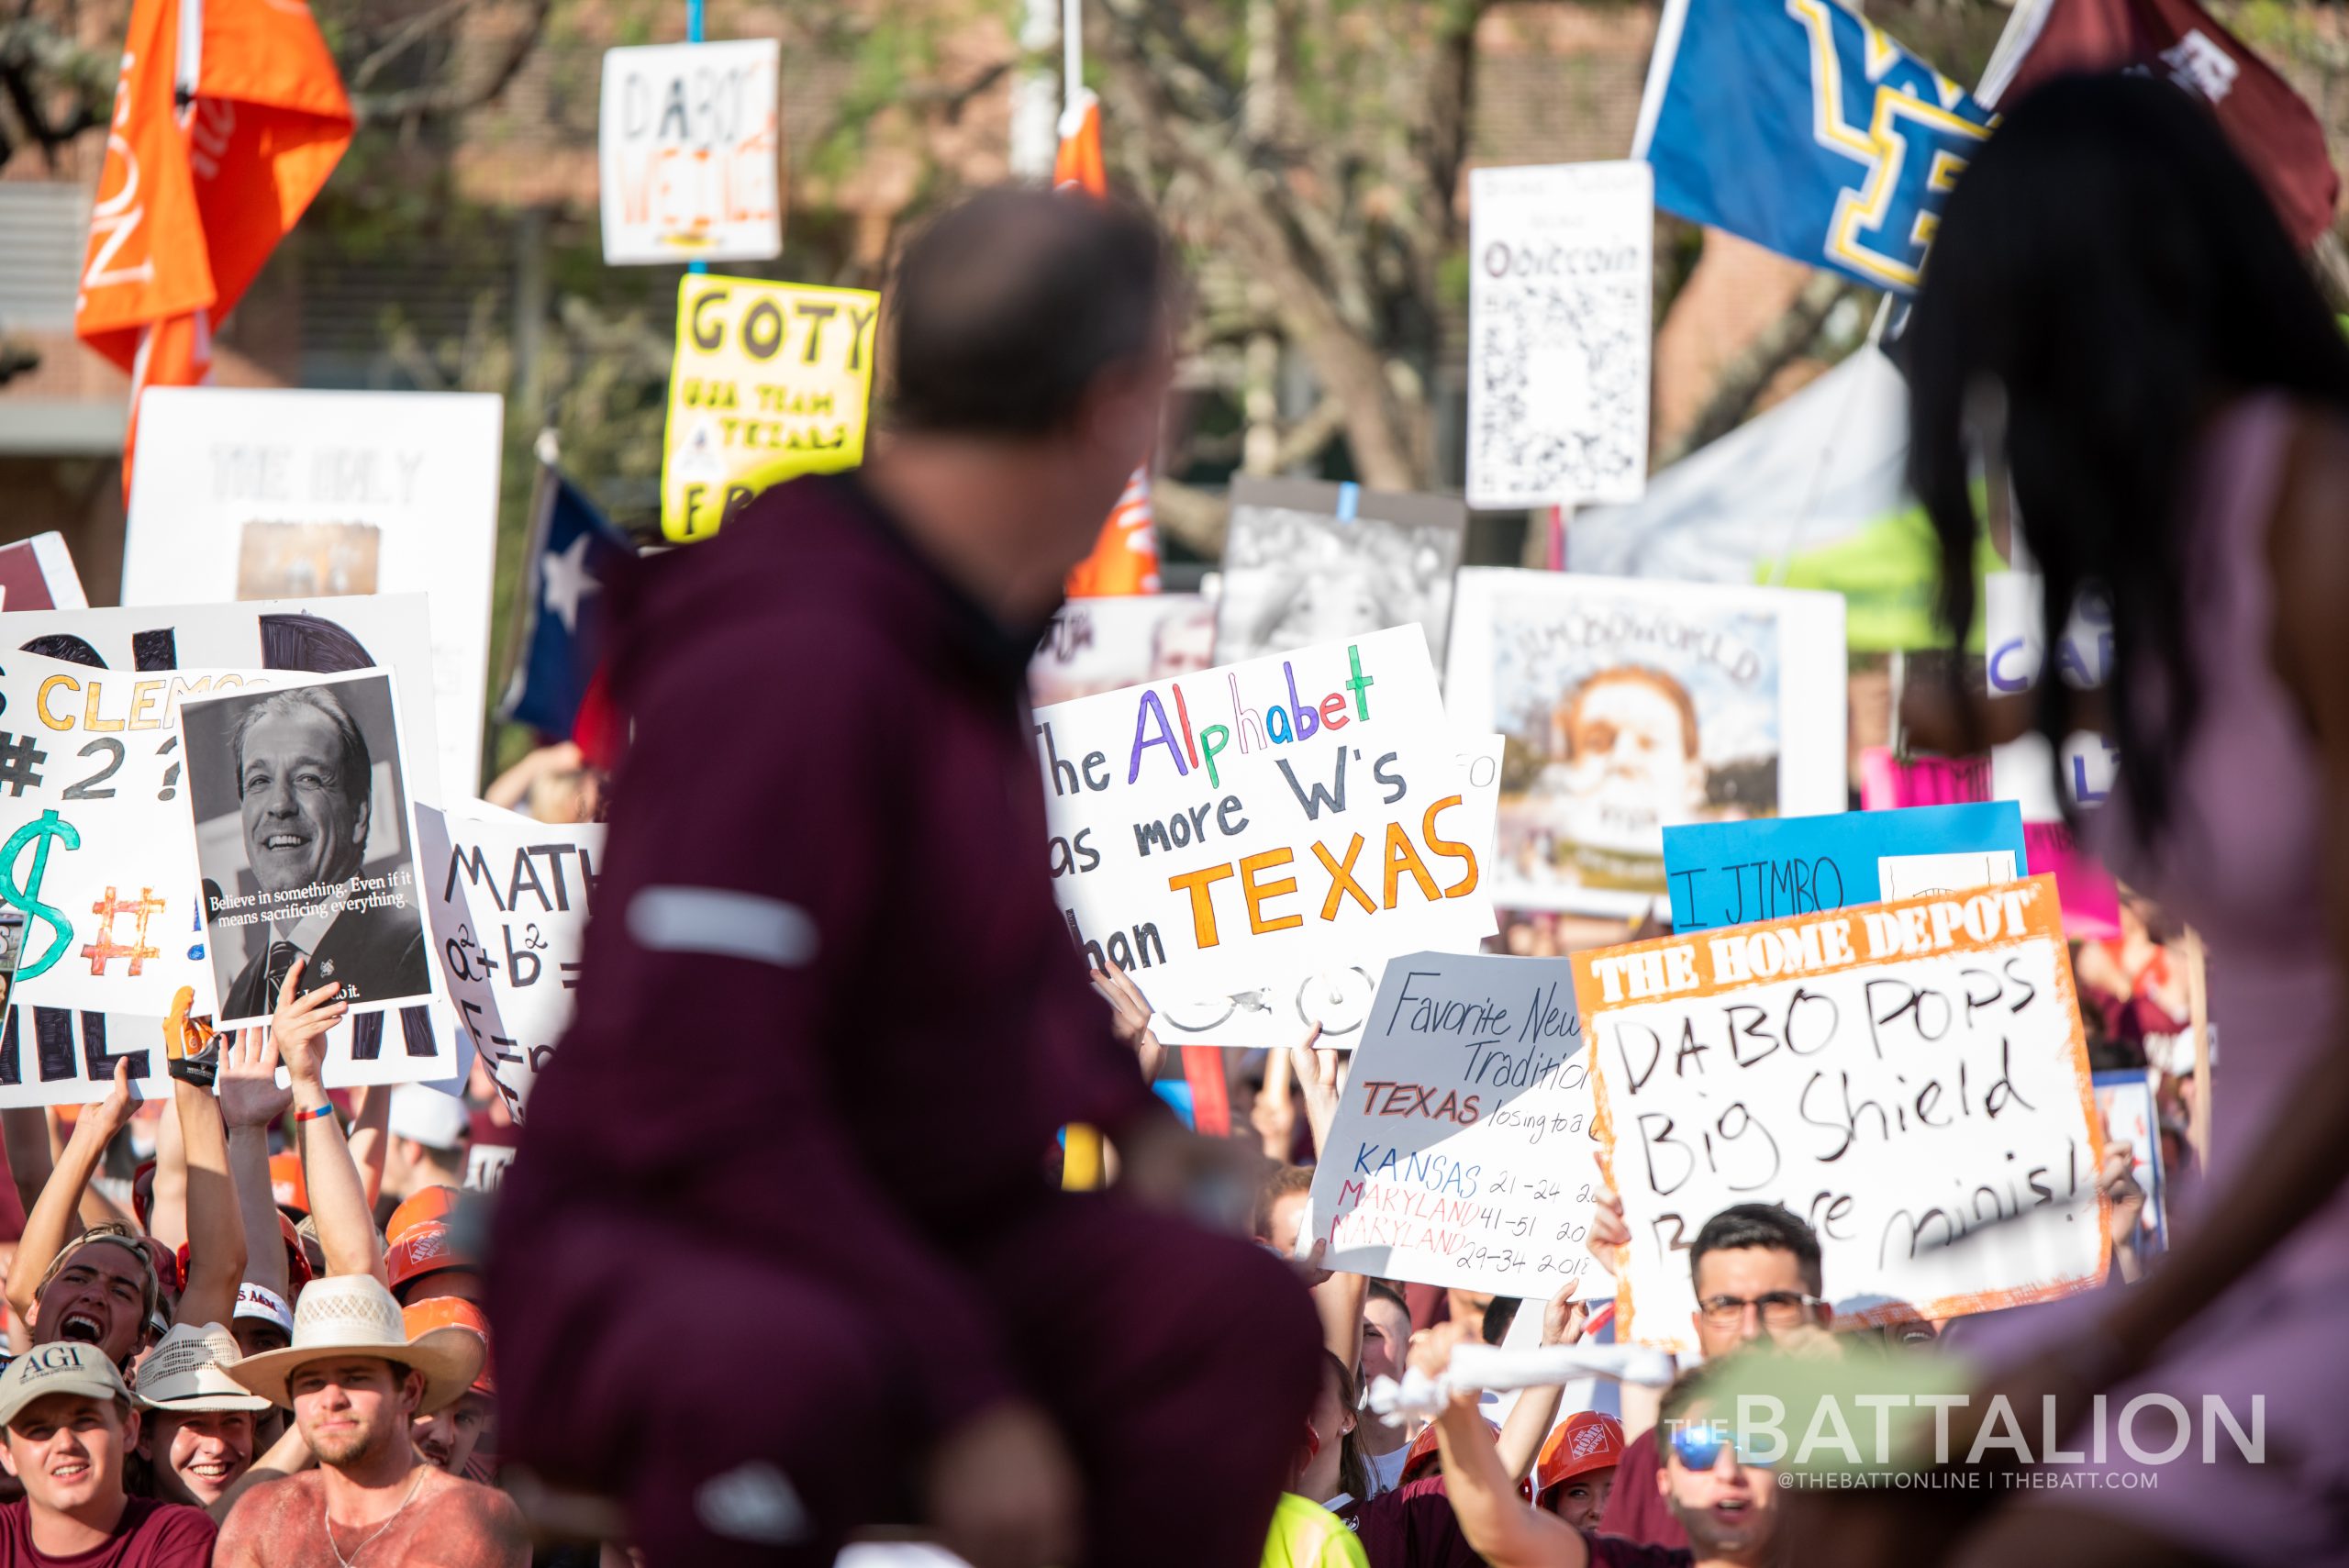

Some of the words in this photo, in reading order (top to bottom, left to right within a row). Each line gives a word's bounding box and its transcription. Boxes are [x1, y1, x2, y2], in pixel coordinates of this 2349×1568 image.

[693, 290, 876, 371] GOTY
[38, 674, 270, 731] CLEM
[1036, 720, 1111, 797] he
[1128, 644, 1375, 789] Alphabet
[1048, 826, 1101, 879] as
[1133, 794, 1250, 858] more
[1275, 744, 1408, 821] W's
[209, 892, 256, 912] Believe
[258, 889, 273, 906] in
[273, 881, 348, 903] something.
[350, 874, 386, 894] Even
[386, 872, 400, 888] if
[401, 870, 413, 885] it
[217, 909, 260, 929] means
[260, 899, 328, 923] sacrificing
[330, 890, 409, 915] everything.
[1065, 906, 1167, 982] han
[1168, 794, 1479, 950] TEXAS
[1720, 855, 1845, 926] JIMBO
[1590, 941, 1701, 1006] THE
[1708, 918, 1856, 986] HOME
[1864, 887, 2033, 961] DEPOT
[1386, 972, 1512, 1037] Favorite
[1519, 981, 1584, 1044] New
[1613, 986, 1840, 1095] DABO
[1363, 1079, 1481, 1128] TEXAS
[1487, 1097, 1546, 1145] losing
[1551, 1112, 1568, 1134] to
[1569, 1113, 1584, 1133] a
[1635, 1090, 1782, 1195] Big
[1799, 1036, 2038, 1163] Shield
[1337, 1178, 1482, 1229] MARYLAND
[1353, 1140, 1482, 1200] KANSAS
[1330, 1213, 1468, 1257] MARYLAND
[18, 1345, 85, 1380] AGI
[1573, 1424, 1604, 1457] HOME
